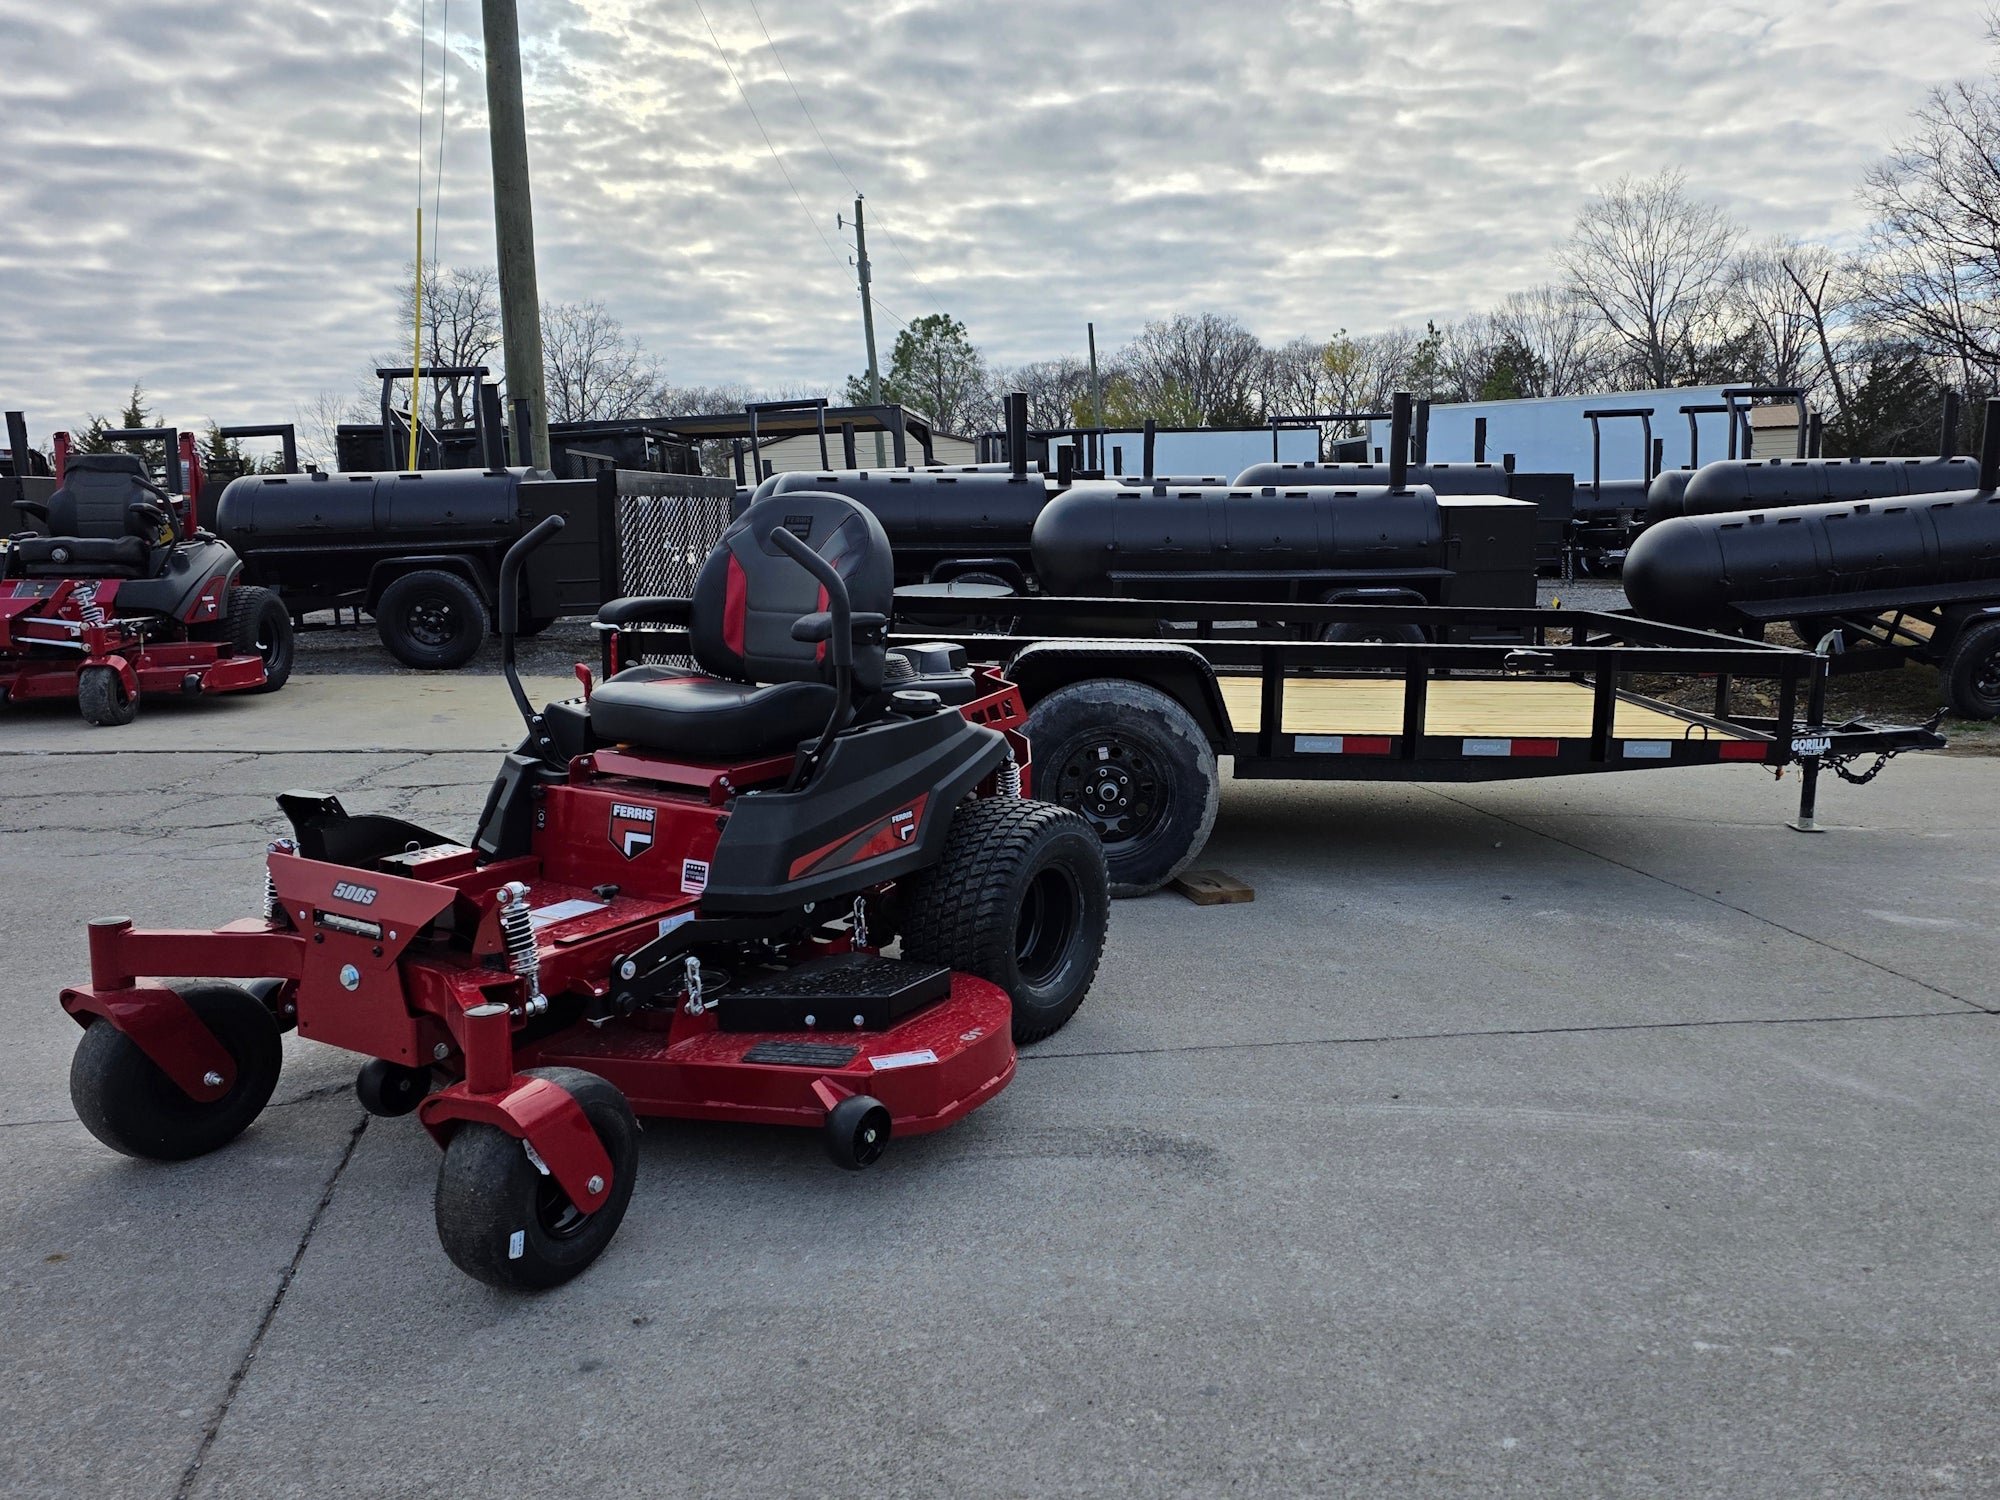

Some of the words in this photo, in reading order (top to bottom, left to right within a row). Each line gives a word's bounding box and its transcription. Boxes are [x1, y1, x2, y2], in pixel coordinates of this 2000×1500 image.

[1791, 738, 1831, 751] GORILLA
[613, 804, 654, 821] FERRIS
[892, 810, 913, 823] FERRIS
[333, 882, 377, 905] 500S
